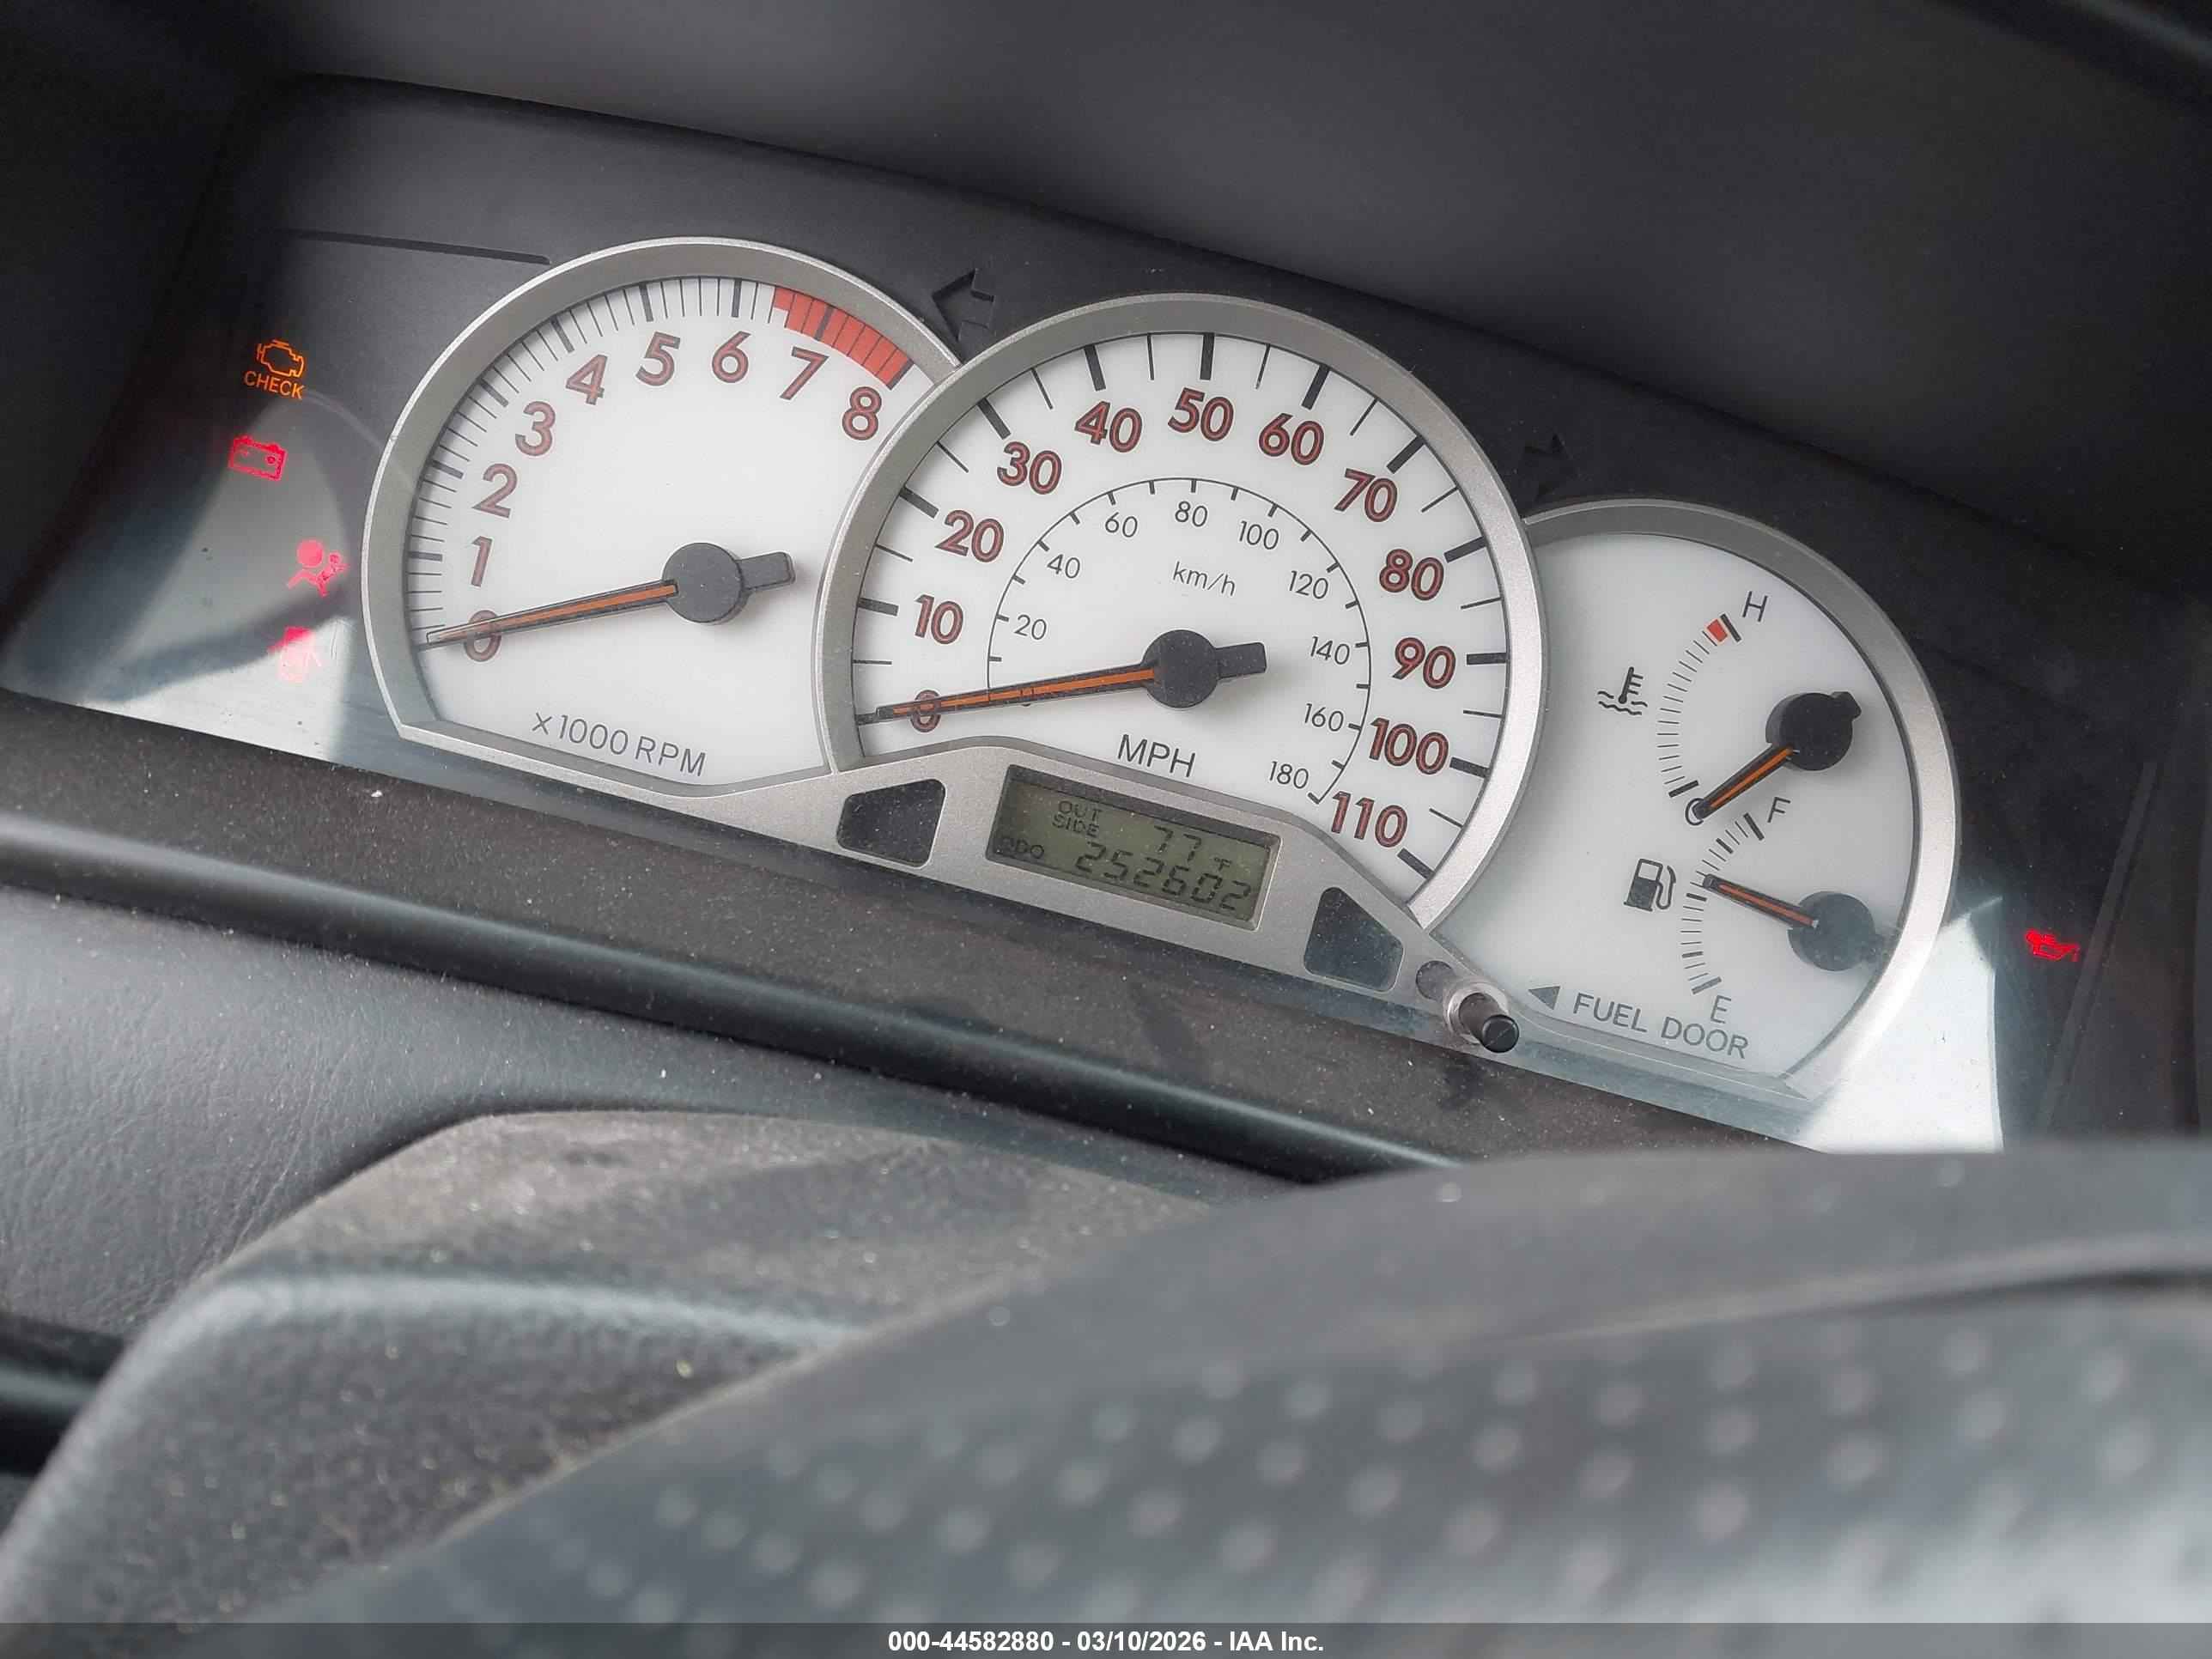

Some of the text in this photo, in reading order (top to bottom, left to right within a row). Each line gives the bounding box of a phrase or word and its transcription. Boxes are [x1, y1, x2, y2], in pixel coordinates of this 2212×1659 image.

[565, 355, 610, 405] 4
[635, 331, 682, 386] 5
[711, 331, 751, 383] 6
[780, 347, 830, 400] 7
[244, 371, 307, 399] CHECK
[514, 401, 556, 457] 3
[841, 386, 884, 441] 8
[1074, 400, 1143, 453] 40
[1168, 387, 1235, 441] 50
[1258, 412, 1325, 465] 60
[471, 463, 518, 519] 2
[996, 441, 1063, 495] 30
[1174, 500, 1209, 527] 80
[1334, 468, 1399, 522] 70
[934, 509, 1005, 562] 20
[1104, 512, 1139, 538] 60
[1238, 520, 1279, 550] 100
[471, 535, 494, 588] 1
[1047, 554, 1081, 580] 40
[1172, 561, 1237, 597] km/h
[1288, 569, 1329, 599] 120
[1378, 548, 1444, 601] 80
[914, 594, 964, 645] 10
[1014, 614, 1048, 641] 20
[1741, 591, 1769, 623] H
[463, 610, 502, 662] 0
[1310, 635, 1351, 665] 140
[1391, 636, 1456, 690] 90
[910, 690, 941, 732] 0
[1304, 702, 1345, 732] 160
[635, 735, 708, 777] RPM
[1117, 733, 1196, 778] MPH
[1369, 717, 1449, 775] 100
[1268, 760, 1310, 790] 180
[1051, 813, 1100, 838] SIDE
[1057, 799, 1103, 820] OUT
[1330, 791, 1407, 848] 110
[1766, 795, 1791, 823] F
[1153, 825, 1202, 862] 77
[995, 835, 1252, 911] ODO 252602
[1572, 993, 1750, 1060] FUEL DOOR
[1710, 995, 1733, 1024] E
